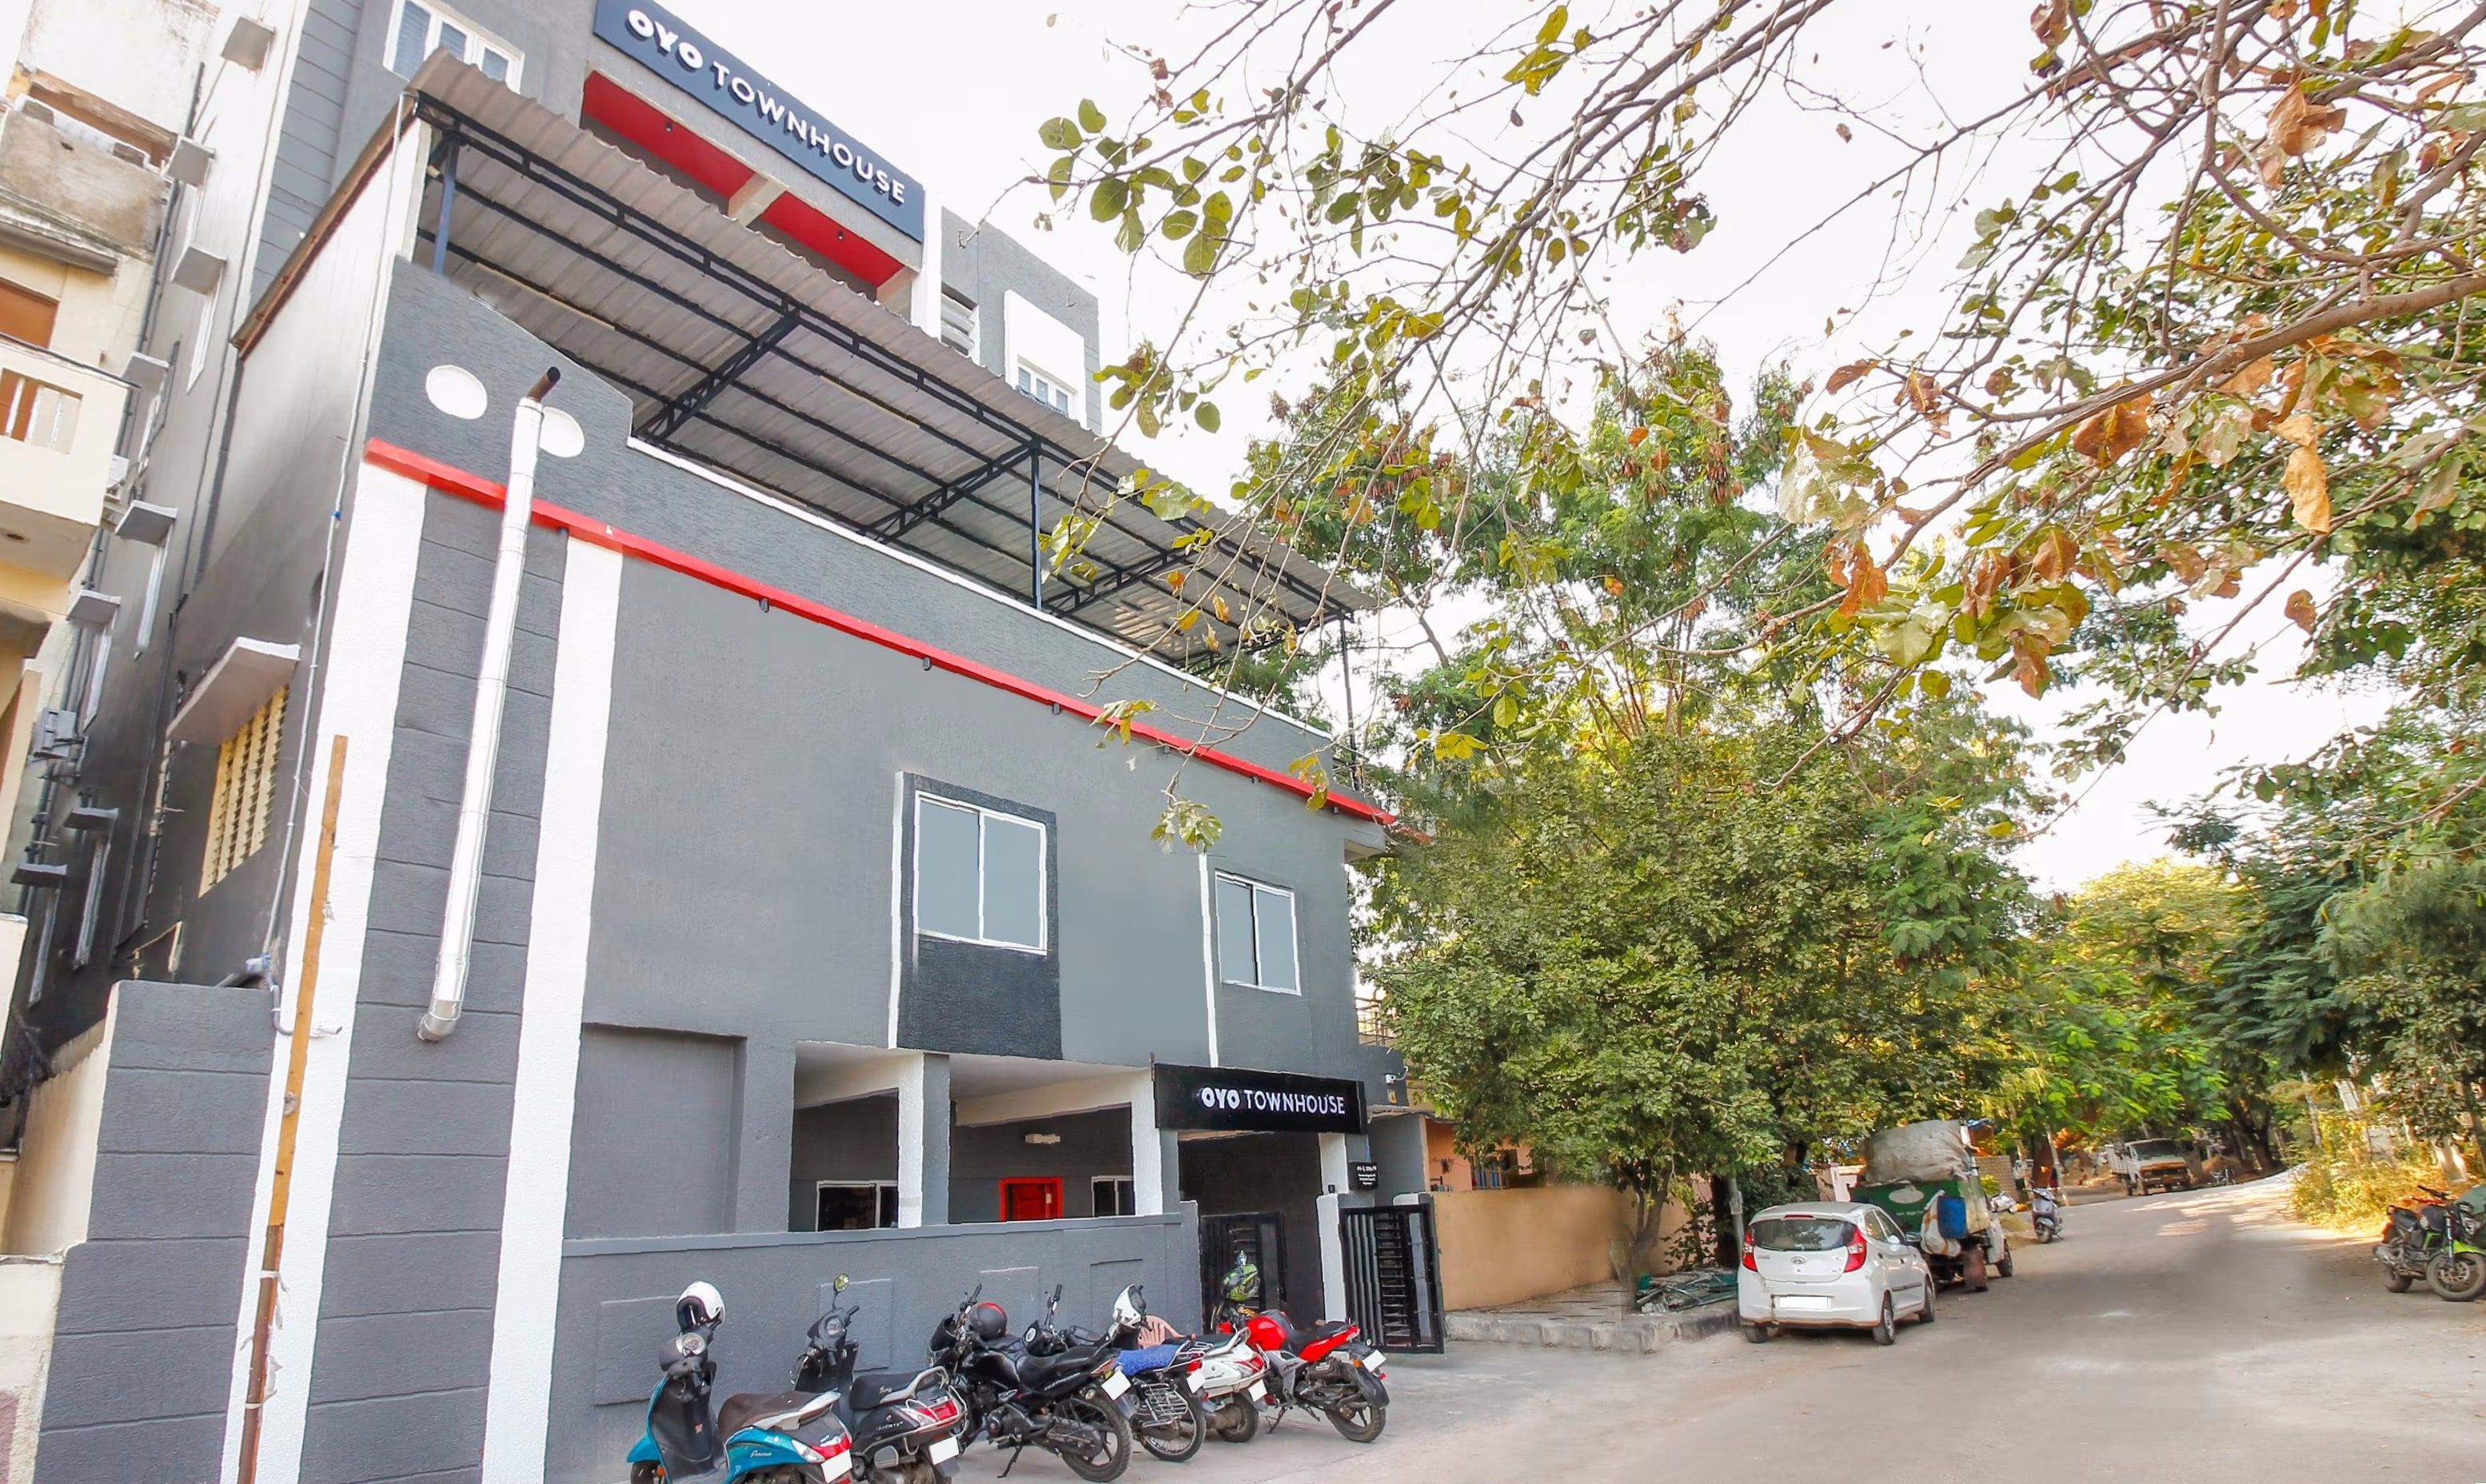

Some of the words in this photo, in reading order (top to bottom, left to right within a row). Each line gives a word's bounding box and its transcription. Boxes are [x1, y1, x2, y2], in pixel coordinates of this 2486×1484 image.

[627, 10, 704, 70] OYO
[712, 61, 906, 205] TOWNHOUSE
[1201, 1087, 1240, 1109] OYO
[1243, 1089, 1346, 1115] TOWNHOUSE
